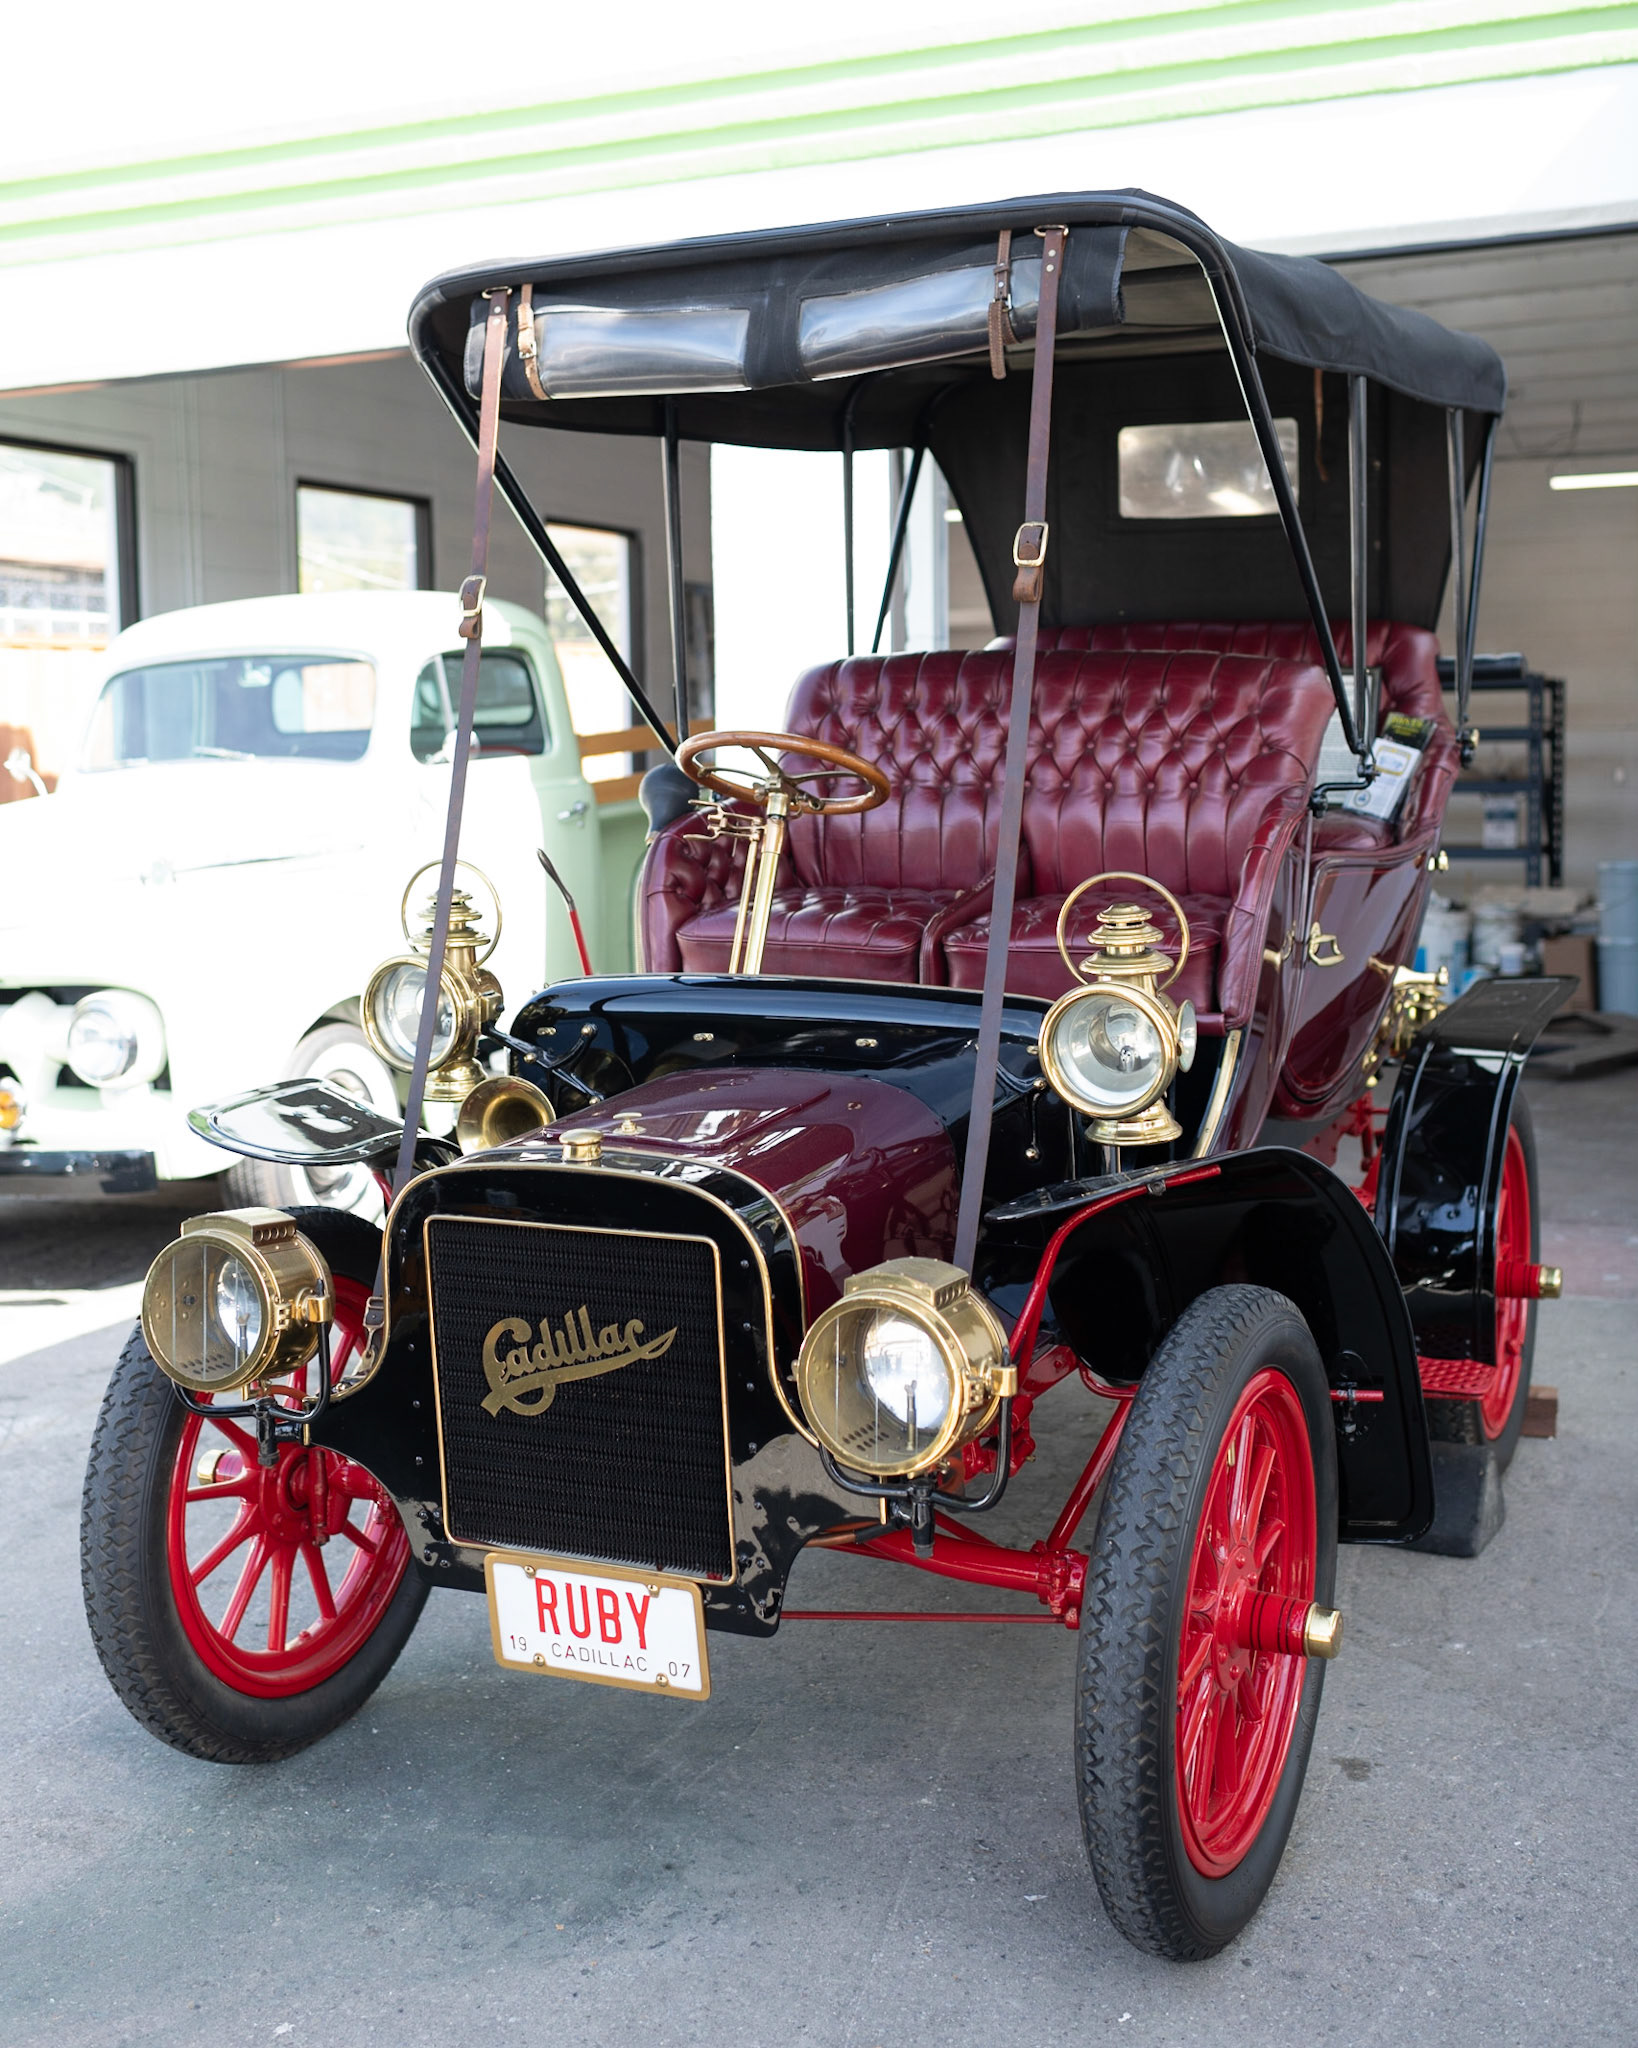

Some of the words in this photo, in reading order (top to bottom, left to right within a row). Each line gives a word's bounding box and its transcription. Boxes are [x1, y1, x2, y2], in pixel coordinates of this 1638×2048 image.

[481, 1305, 678, 1417] Cadillac
[535, 1577, 650, 1650] RUBY
[510, 1635, 528, 1651] 19
[552, 1643, 647, 1672] CADILLAC
[669, 1662, 690, 1678] 07
